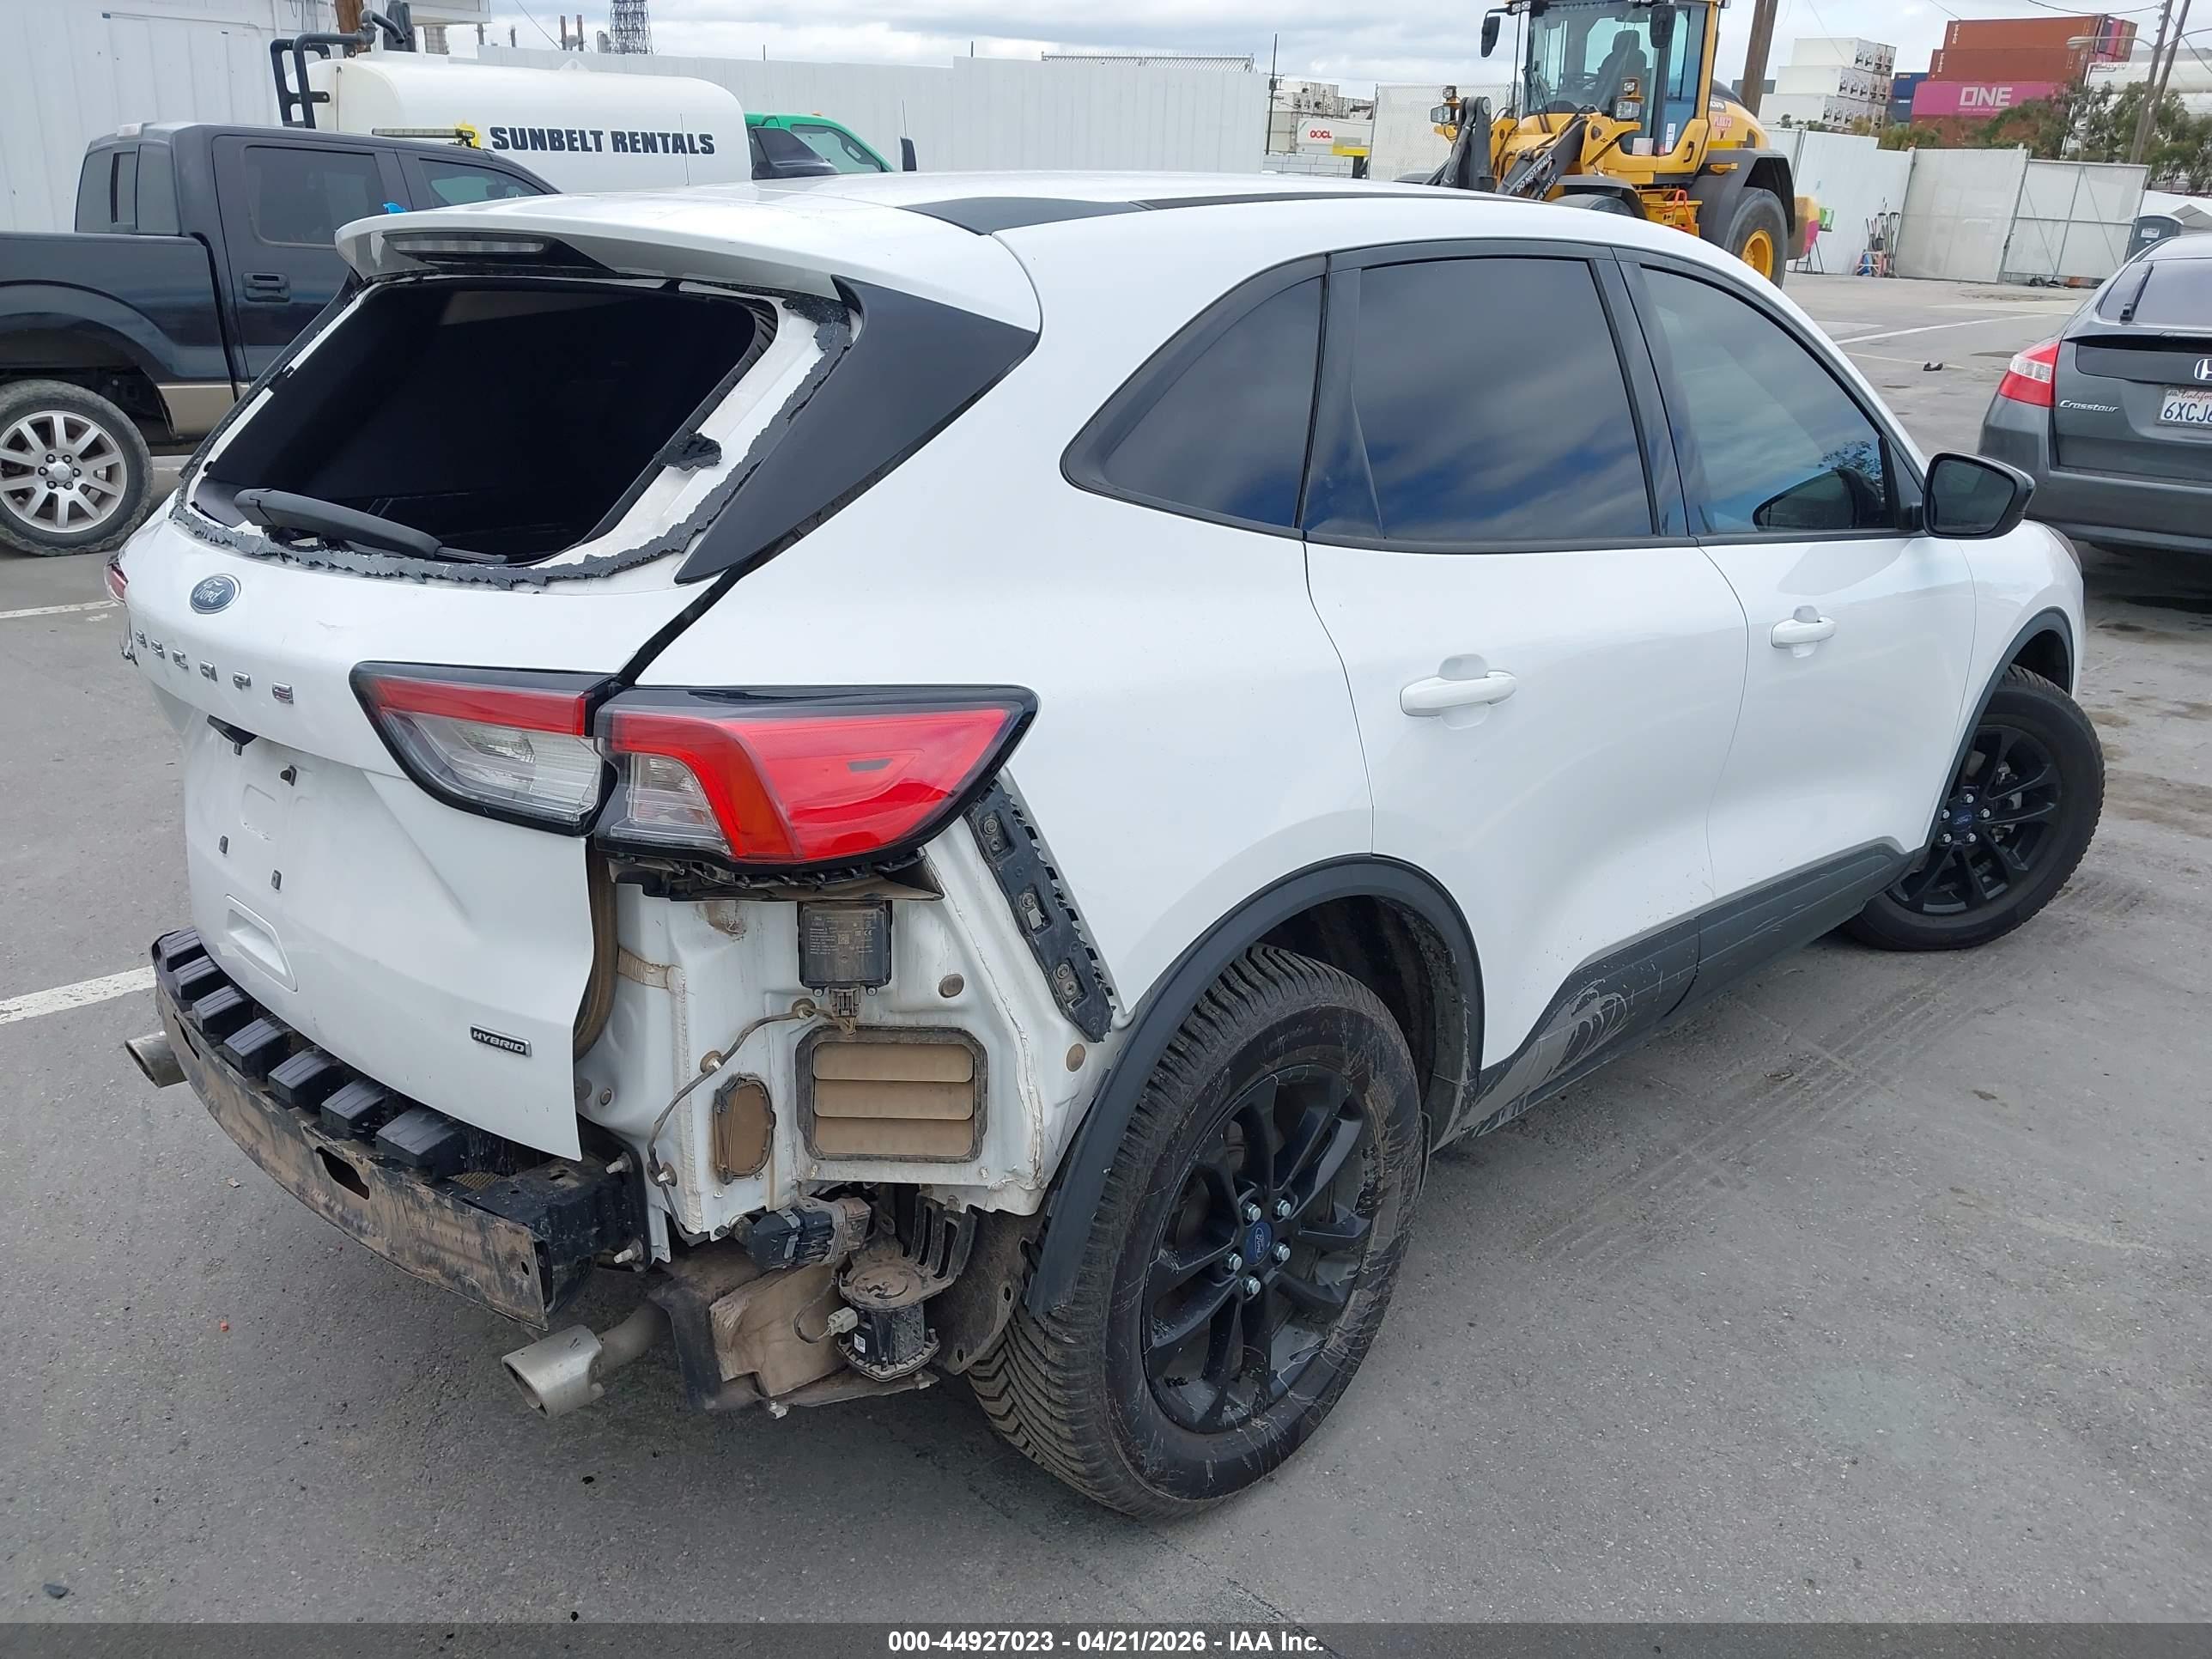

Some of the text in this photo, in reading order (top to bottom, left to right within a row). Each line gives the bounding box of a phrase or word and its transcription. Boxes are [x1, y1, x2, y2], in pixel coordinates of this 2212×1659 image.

[1959, 87, 2013, 106] ONE
[489, 126, 715, 155] SUNBELT RENTALS
[1310, 130, 1333, 139] OOCL
[1516, 181, 1526, 193] DO
[2059, 399, 2119, 413] Crosstour
[194, 579, 226, 604] Ford
[135, 629, 295, 705] ESCAPE
[472, 1030, 526, 1053] HYBRID
